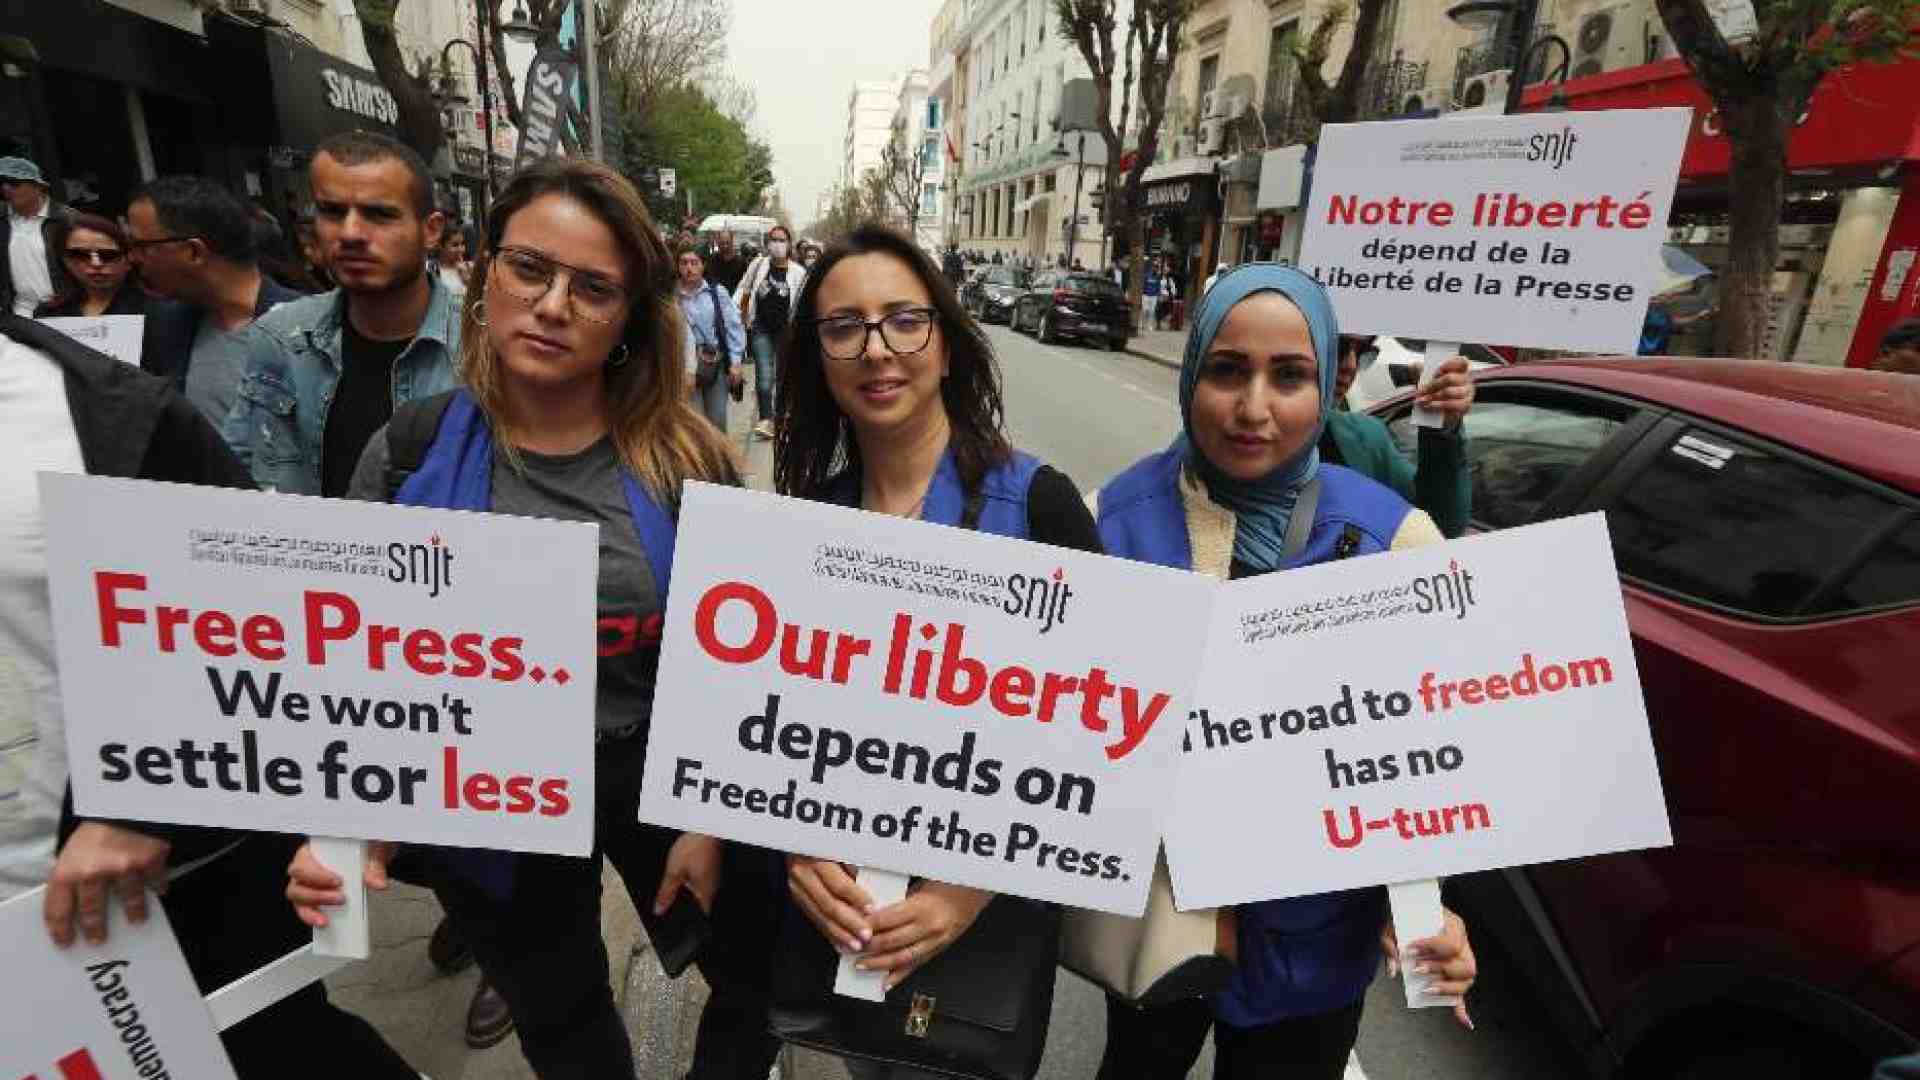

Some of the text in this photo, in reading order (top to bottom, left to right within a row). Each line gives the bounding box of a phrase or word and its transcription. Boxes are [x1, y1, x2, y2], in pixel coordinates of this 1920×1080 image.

[321, 68, 398, 125] SAMSU
[1527, 126, 1577, 170] snjt
[1327, 191, 1652, 229] Notre liberté
[1313, 265, 1635, 303] Liberté de la Presse
[1361, 238, 1570, 265] dépend de la
[388, 532, 454, 598] snjt
[1413, 559, 1475, 621] snjt
[94, 571, 287, 661] Free
[303, 590, 571, 684] Press..
[1003, 566, 1073, 634] snjt
[205, 666, 473, 735] We won't
[694, 581, 872, 684] Our
[883, 612, 1170, 761] liberty
[1259, 685, 1357, 740] road
[1361, 689, 1412, 723] to
[1418, 655, 1614, 710] freedom
[99, 730, 571, 817] settle for less
[738, 693, 1097, 815] depends on
[1324, 745, 1465, 789] has no
[672, 757, 1131, 882] Freedom of the Press.
[1324, 802, 1491, 849] U-turn
